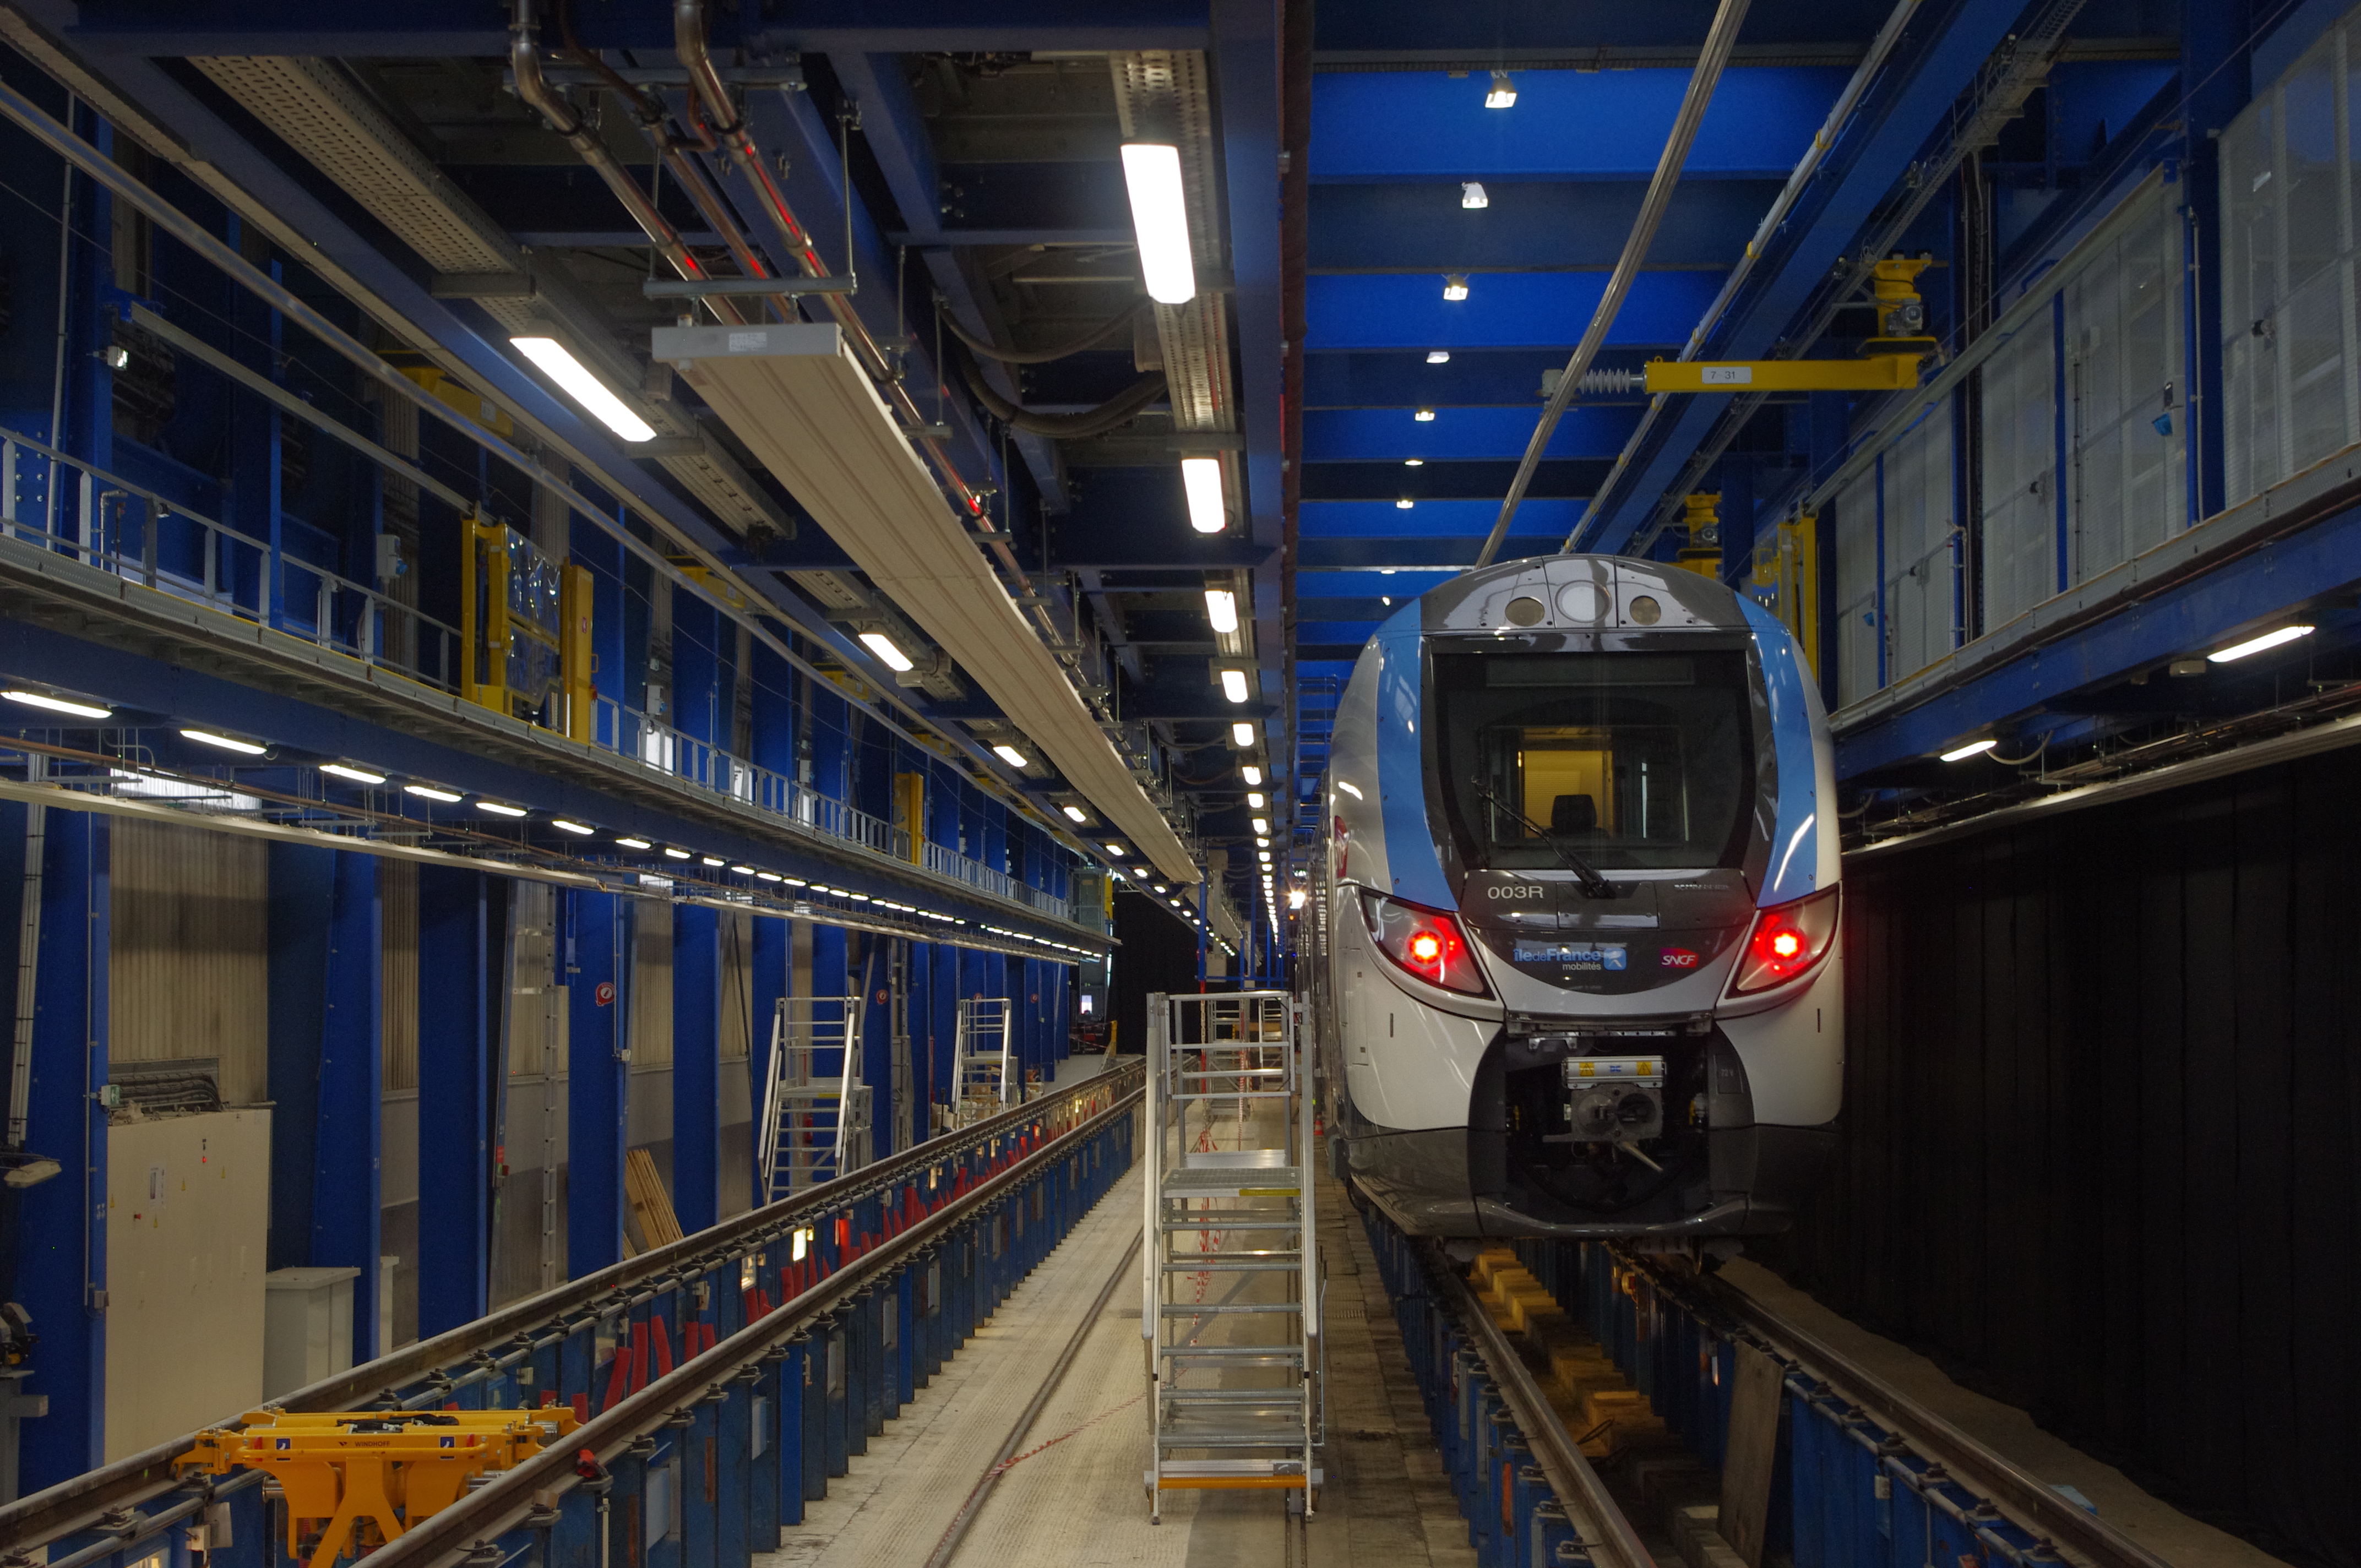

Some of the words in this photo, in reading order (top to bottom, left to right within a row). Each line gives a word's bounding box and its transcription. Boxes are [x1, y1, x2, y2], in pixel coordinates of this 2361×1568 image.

[1710, 371, 1716, 379] 7
[1724, 371, 1736, 380] 31
[1487, 886, 1544, 899] 003R
[1661, 955, 1696, 966] SNCF
[1562, 962, 1602, 971] mobilités
